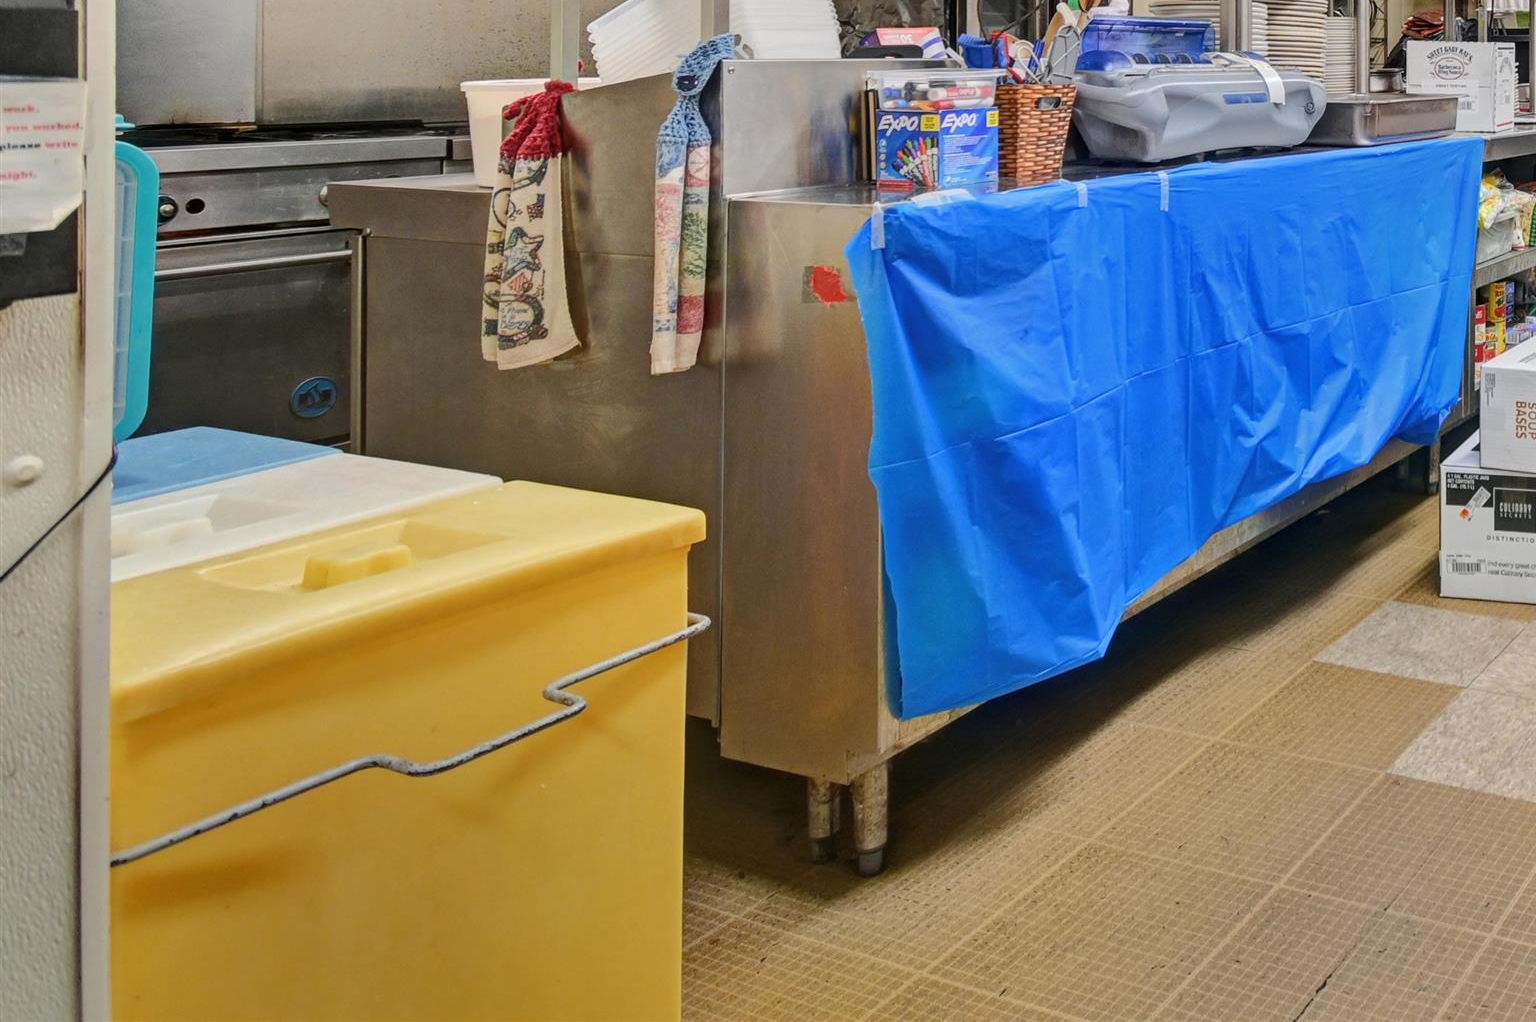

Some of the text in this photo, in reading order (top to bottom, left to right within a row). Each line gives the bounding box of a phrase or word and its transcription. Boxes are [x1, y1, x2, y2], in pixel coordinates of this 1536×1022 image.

[878, 114, 919, 137] EXPO
[941, 112, 978, 133] EXPO
[1515, 400, 1527, 440] BASES
[1499, 501, 1533, 513] CULINARY
[1499, 512, 1533, 520] SECRETS
